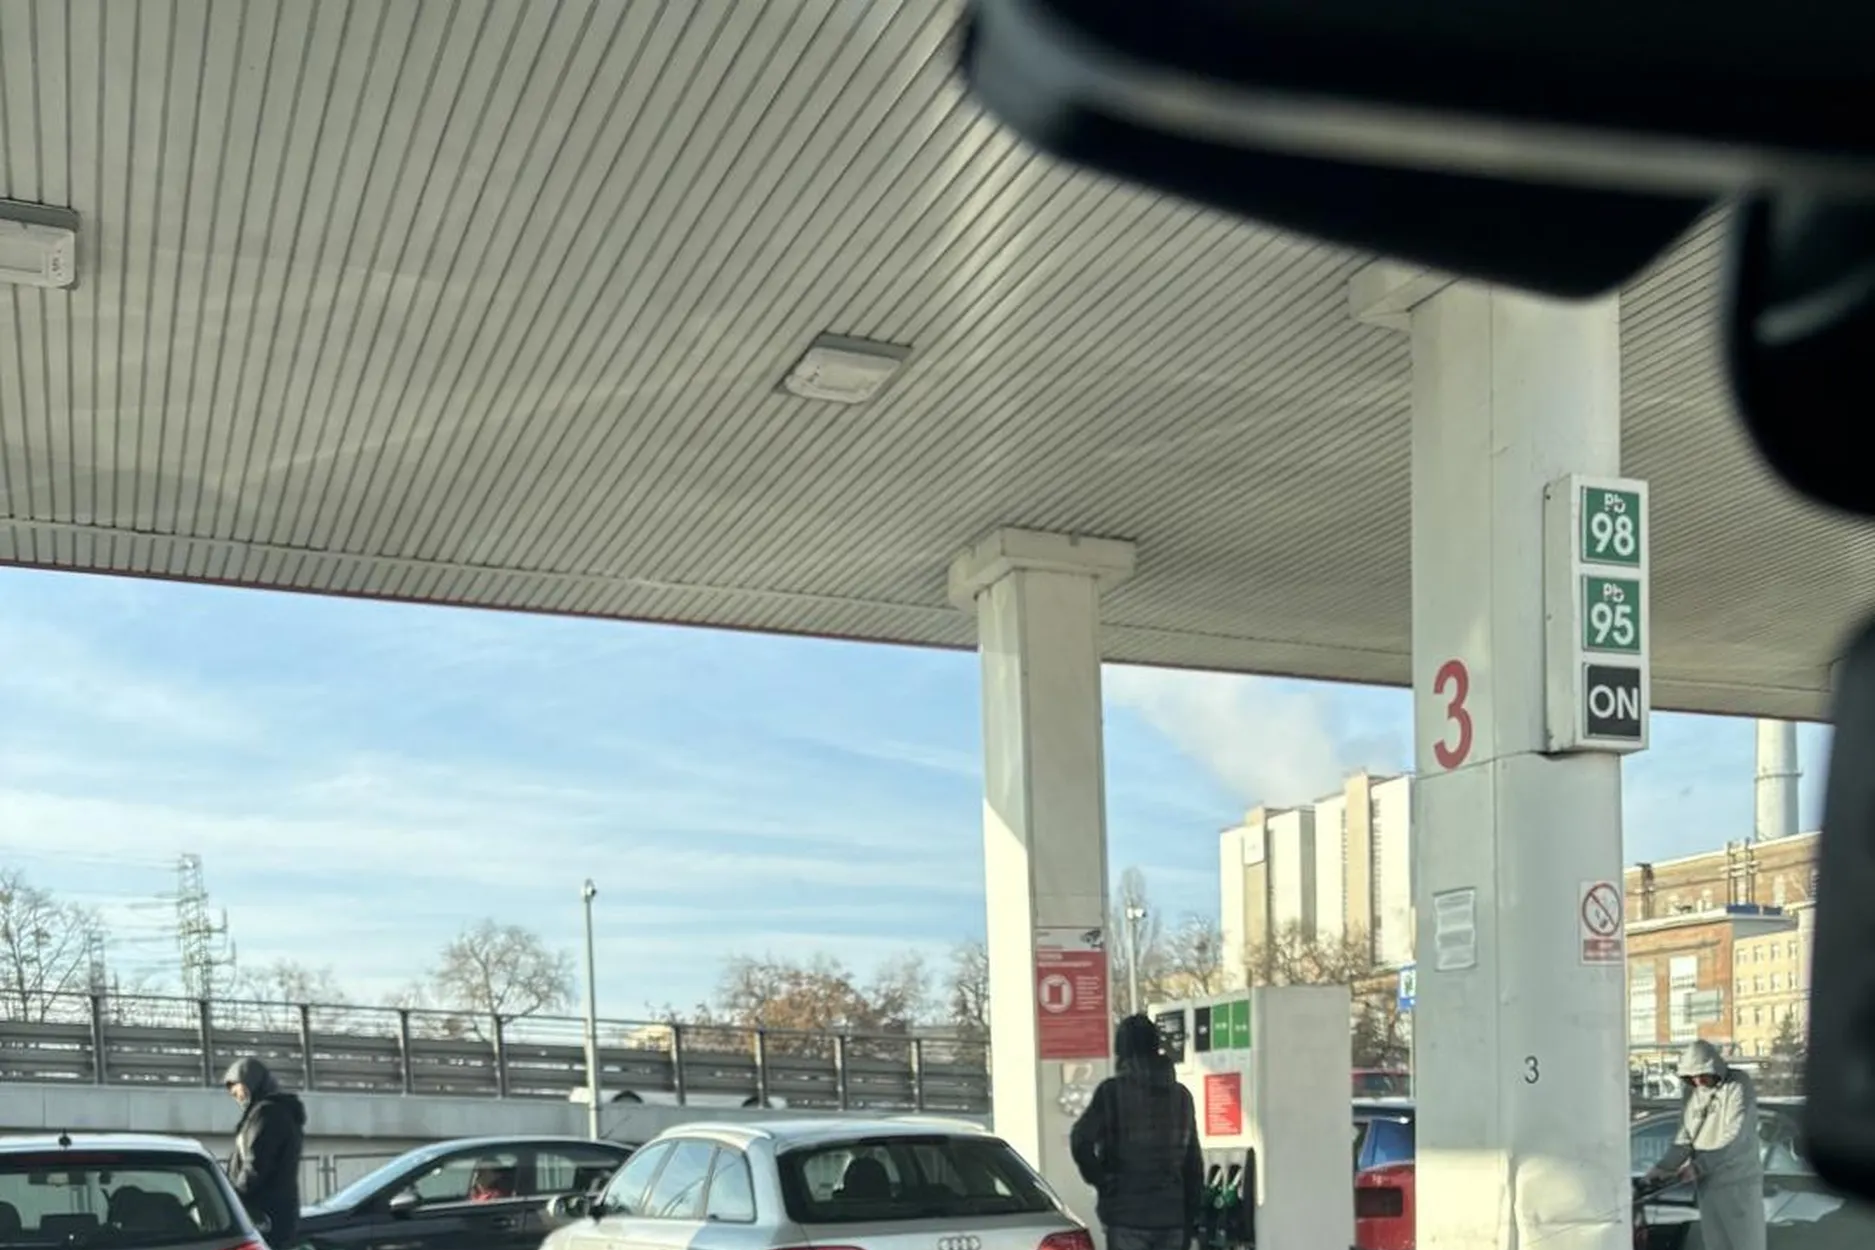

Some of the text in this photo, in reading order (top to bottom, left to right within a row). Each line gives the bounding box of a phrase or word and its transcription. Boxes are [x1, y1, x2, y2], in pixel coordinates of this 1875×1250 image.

[1604, 492, 1626, 513] Pb
[1591, 512, 1635, 556] 98
[1591, 602, 1634, 645] 95
[1434, 659, 1473, 769] 3
[1589, 684, 1639, 720] ON
[1524, 1055, 1540, 1084] 3
